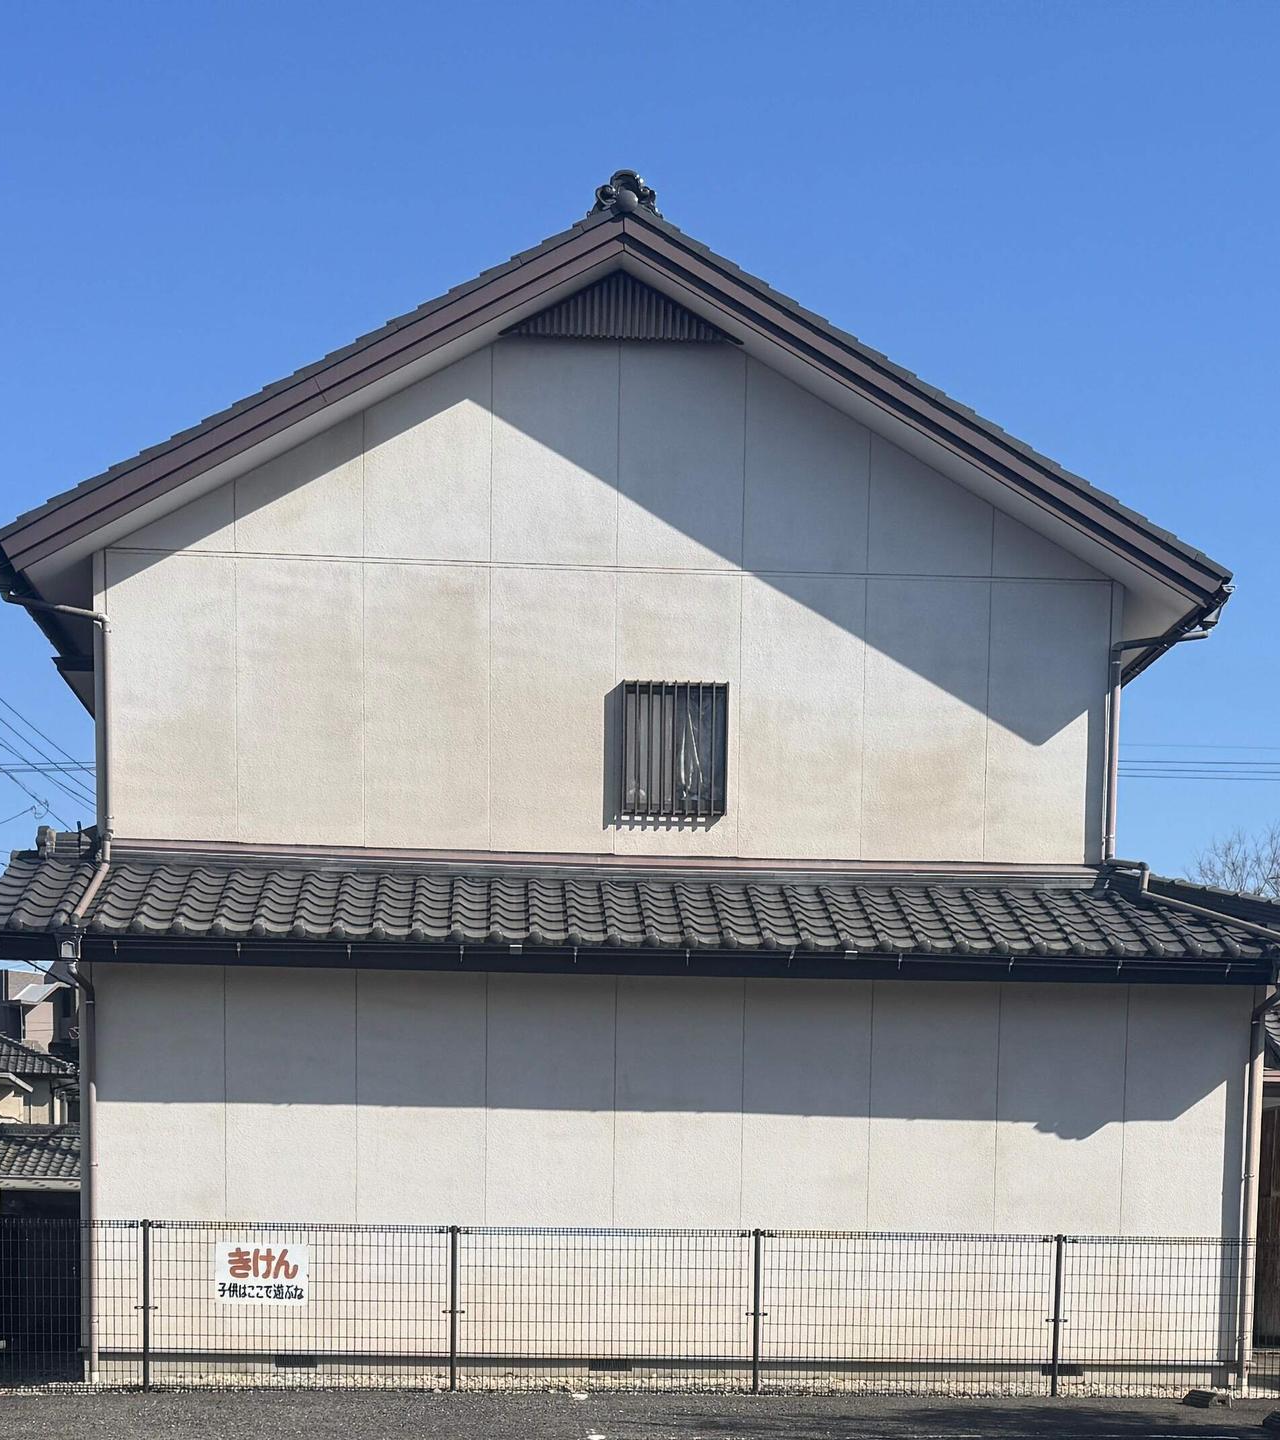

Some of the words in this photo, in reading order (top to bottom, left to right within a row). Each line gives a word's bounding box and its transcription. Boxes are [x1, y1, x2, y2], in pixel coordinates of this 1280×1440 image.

[228, 1247, 299, 1279] きけん
[218, 1282, 304, 1300] 子供はここで遊ぶな
